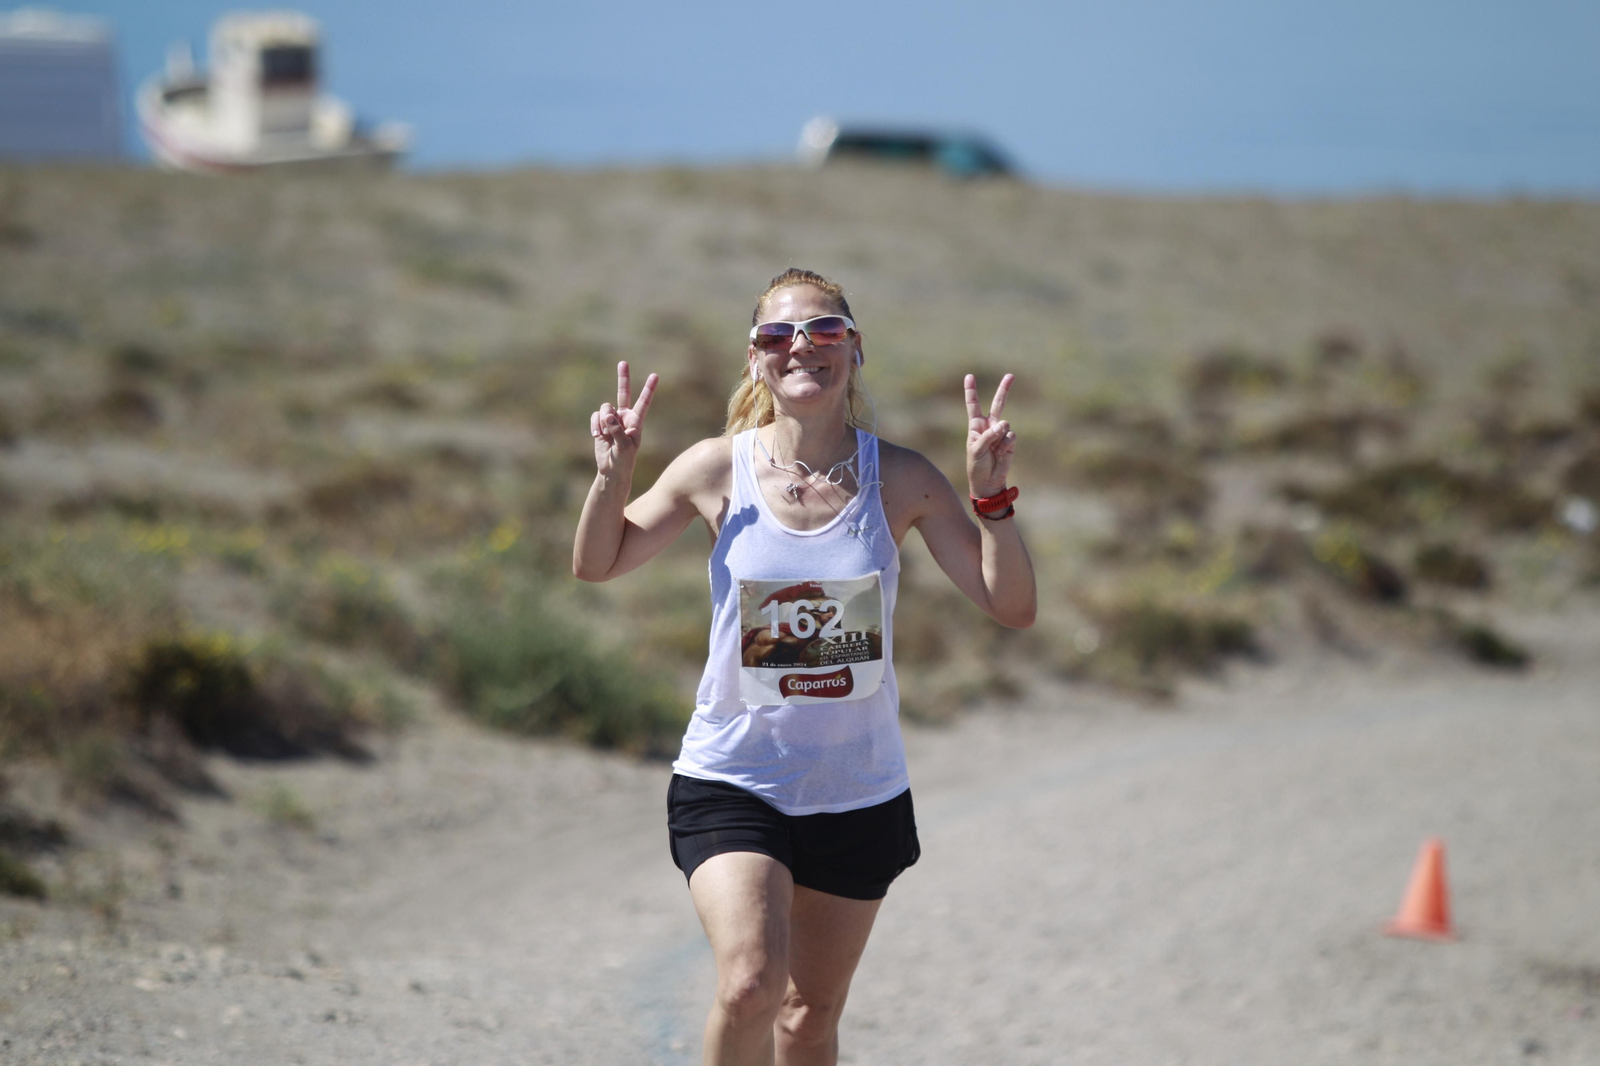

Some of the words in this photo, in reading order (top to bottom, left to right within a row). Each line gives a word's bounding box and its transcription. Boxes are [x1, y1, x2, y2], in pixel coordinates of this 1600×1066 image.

[761, 599, 845, 639] 162
[820, 640, 870, 651] CARRERA
[820, 646, 869, 656] POPULAR
